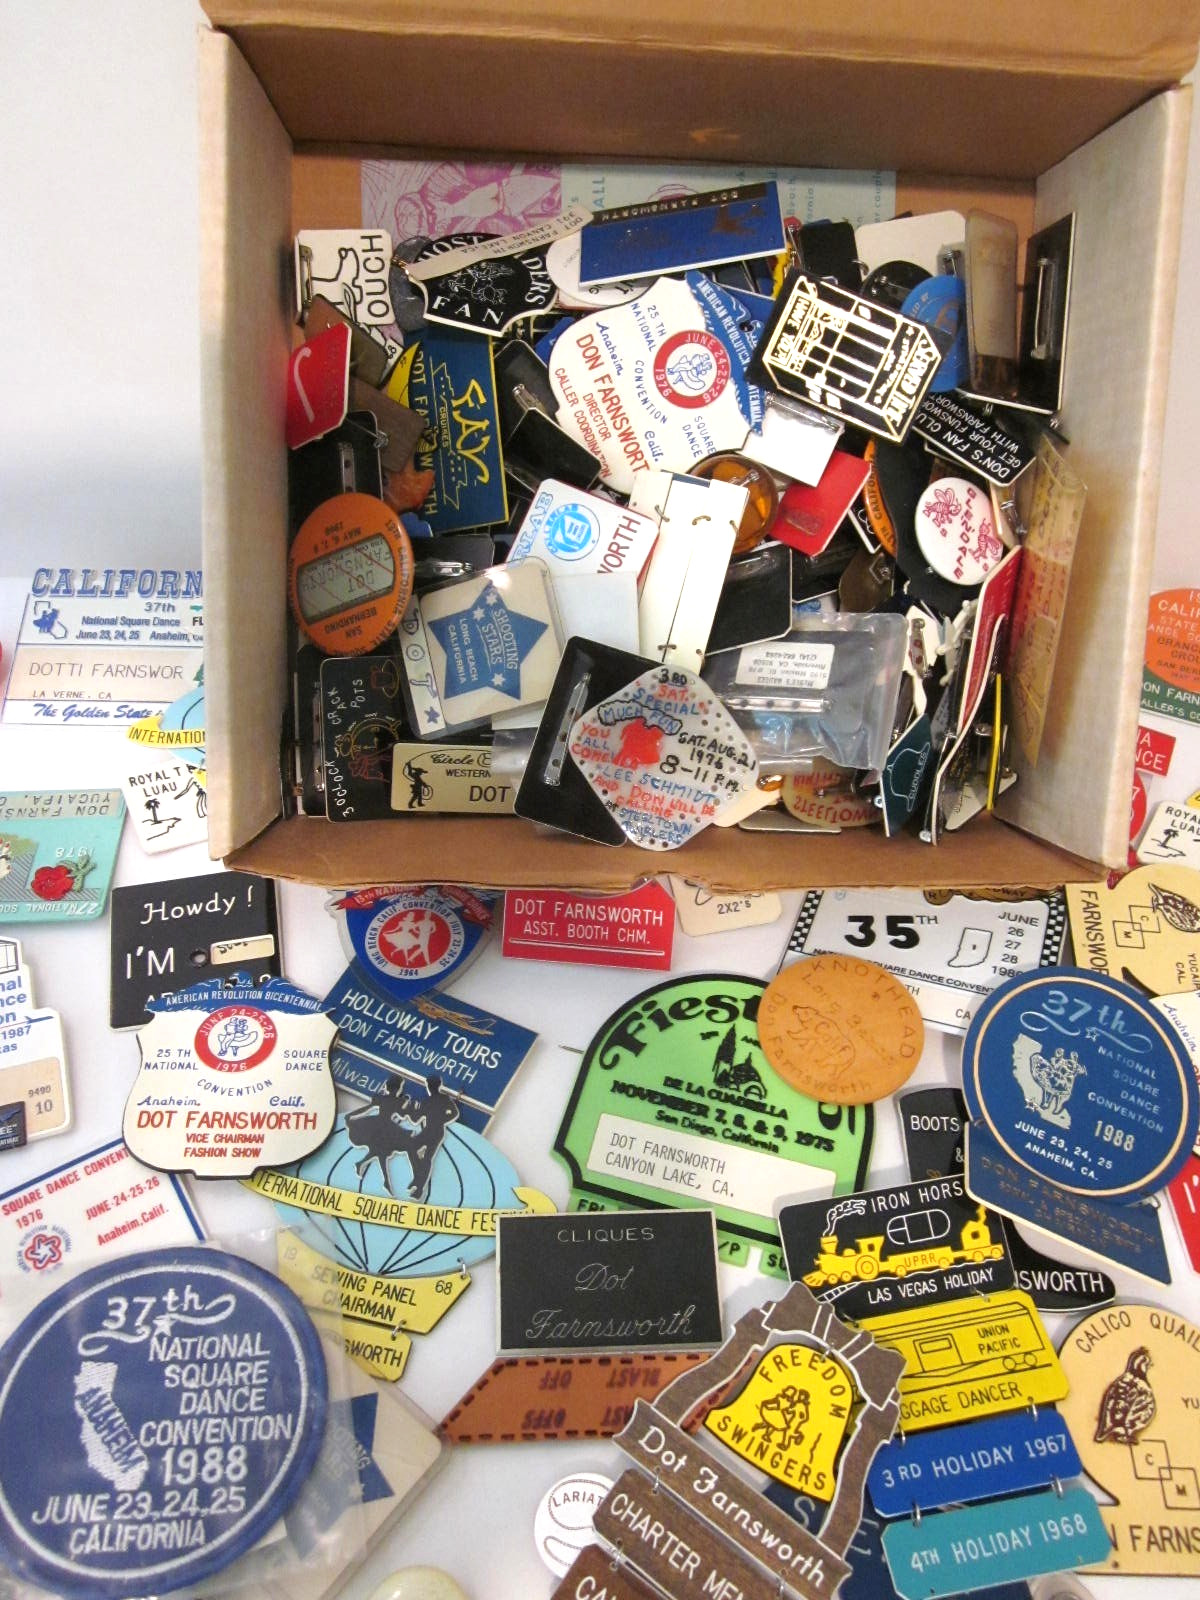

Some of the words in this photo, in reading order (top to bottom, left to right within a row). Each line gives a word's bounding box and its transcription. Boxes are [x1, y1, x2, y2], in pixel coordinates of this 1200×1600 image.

[361, 233, 389, 319] OUCH
[431, 295, 504, 325] FAN
[631, 302, 655, 353] NATIONAL
[576, 334, 605, 371] DON
[686, 334, 715, 350] JUNE
[555, 367, 580, 408] CALLER
[634, 360, 668, 424] CONVENTION
[655, 368, 672, 396] 1976
[583, 393, 612, 442] DIRECTOR
[683, 424, 703, 458] DANCE
[943, 431, 971, 451] FAN
[969, 434, 998, 452] YOUR
[992, 433, 1020, 453] WITH
[972, 451, 1010, 478] DON'S
[999, 455, 1021, 468] GET
[145, 602, 175, 612] 37th
[76, 630, 97, 640] June
[130, 631, 140, 640] 25
[82, 616, 118, 626] National
[120, 616, 150, 627] Square
[153, 617, 180, 626] Dance
[459, 618, 470, 647] LONG
[481, 623, 503, 665] STARS
[492, 608, 519, 670] SHOOTING
[448, 625, 467, 684] CALIFORNIA
[464, 648, 478, 681] BEACH
[29, 662, 83, 676] DOTTI
[33, 690, 45, 699] LA
[351, 679, 367, 709] POTS
[34, 703, 58, 717] The
[62, 704, 110, 721] Golden
[603, 706, 645, 724] MUCH
[651, 710, 680, 733] FUN
[580, 722, 611, 739] YOU
[583, 738, 610, 751] ALL
[128, 771, 170, 788] ROYAL
[143, 781, 178, 797] LUAU
[602, 767, 633, 782] LEE
[640, 774, 717, 804] SCHMIDT
[469, 785, 511, 803] DOT
[75, 804, 109, 817] DON
[55, 846, 94, 860] 1978
[140, 892, 236, 925] Howdy
[515, 899, 545, 915] DOT
[555, 901, 664, 927] FARNSWORTH
[998, 911, 1039, 927] JUNE
[524, 920, 559, 937] ASST.
[567, 923, 609, 942] BOOTH
[617, 928, 651, 945] CHM.
[1004, 940, 1021, 950] 27
[1008, 926, 1024, 937] 26
[126, 947, 175, 980] I'M
[1001, 953, 1018, 964] 28
[906, 968, 946, 986] DANCE
[166, 990, 209, 1006] AMERICAN
[211, 990, 262, 1000] REVOLUTION
[265, 991, 322, 1011] BICENTENNIAL
[1042, 989, 1129, 1034] 37th
[1, 1024, 32, 1040] 1987
[200, 1013, 224, 1036] JUNE
[341, 988, 438, 1042] HOLLOWAY
[444, 1030, 502, 1070] TOURS
[157, 1049, 171, 1058] 25
[178, 1049, 191, 1058] TH
[284, 1049, 327, 1059] SQUARE
[338, 1013, 371, 1040] DON
[374, 1029, 478, 1085] FARNSWORTH
[144, 1061, 199, 1071] NATIONAL
[216, 1062, 248, 1073] 1976
[286, 1062, 322, 1071] DANCE
[1098, 1046, 1157, 1080] NATIONAL
[197, 1078, 273, 1097] CONVENTION
[686, 1082, 705, 1097] LA
[1113, 1069, 1160, 1098] SQUARE
[35, 1099, 53, 1116] 10
[270, 1095, 306, 1108] Calif.
[1088, 1092, 1164, 1133] CONVENTION
[1120, 1090, 1161, 1115] DANCE
[137, 1111, 184, 1129] DOT
[186, 1111, 317, 1131] FARNSWORTH
[610, 1079, 710, 1118] NOVEMBER
[753, 1119, 768, 1134] &
[794, 1130, 835, 1152] 1975
[910, 1114, 960, 1132] BOOTS
[186, 1133, 209, 1143] VICE
[214, 1134, 265, 1145] CHAIRMAN
[655, 1109, 679, 1126] San
[681, 1116, 718, 1138] Diego,
[722, 1128, 780, 1154] California
[1014, 1120, 1045, 1140] JUNE
[1097, 1156, 1113, 1169] 25
[1094, 1120, 1136, 1152] 1988
[184, 1147, 228, 1158] FASHION
[232, 1148, 261, 1158] SHOW
[609, 1132, 637, 1150] DOT
[643, 1140, 727, 1176] FARNSWORTH
[605, 1151, 656, 1176] CANYON
[662, 1165, 703, 1190] LAKE,
[712, 1179, 735, 1198] CA.
[1080, 1166, 1099, 1181] CA.
[1, 1189, 43, 1216] SQUARE
[46, 1171, 81, 1194] DANCE
[871, 1194, 910, 1213] IRON
[15, 1209, 44, 1229] 1976
[353, 1196, 406, 1225] SQUARE
[416, 1207, 461, 1230] DANCE
[556, 1227, 656, 1243] CLIQUES
[904, 1253, 937, 1270] UPRR
[312, 1264, 366, 1292] SEWING
[373, 1281, 417, 1306] PANEL
[435, 1280, 453, 1295] 68
[575, 1262, 636, 1293] Dot
[867, 1288, 892, 1304] LAS
[898, 1280, 938, 1299] VEGAS
[945, 1267, 995, 1291] HOLIDAY
[103, 1285, 204, 1329] 37th
[323, 1289, 397, 1322] CHAIRMAN
[525, 1304, 697, 1340] Farnsworth
[977, 1325, 1010, 1339] UNION
[1075, 1310, 1133, 1355] CALICO
[149, 1333, 270, 1362] NATIONAL
[978, 1339, 1021, 1355] PACIFIC
[164, 1360, 269, 1389] SQUARE
[537, 1370, 573, 1391] OFF
[606, 1367, 661, 1389] BLAST
[758, 1348, 849, 1420] FREEDOM
[179, 1388, 266, 1415] DANCE
[957, 1381, 1023, 1411] DANCER
[140, 1414, 293, 1448] CONVENTION
[521, 1407, 567, 1431] OFFS
[162, 1445, 248, 1485] 1988
[716, 1415, 827, 1491] SWINGERS
[932, 1447, 1015, 1479] HOLIDAY
[1024, 1433, 1069, 1460] 1967
[32, 1492, 110, 1525] JUNE
[638, 1425, 687, 1472] Dot
[692, 1466, 826, 1589] Farnsworth
[69, 1520, 206, 1555] CALIFORNIA
[609, 1492, 701, 1580] CHARTER
[909, 1549, 941, 1574] 4TH
[953, 1525, 1032, 1565] HOLIDAY
[1039, 1512, 1089, 1544] 1968
